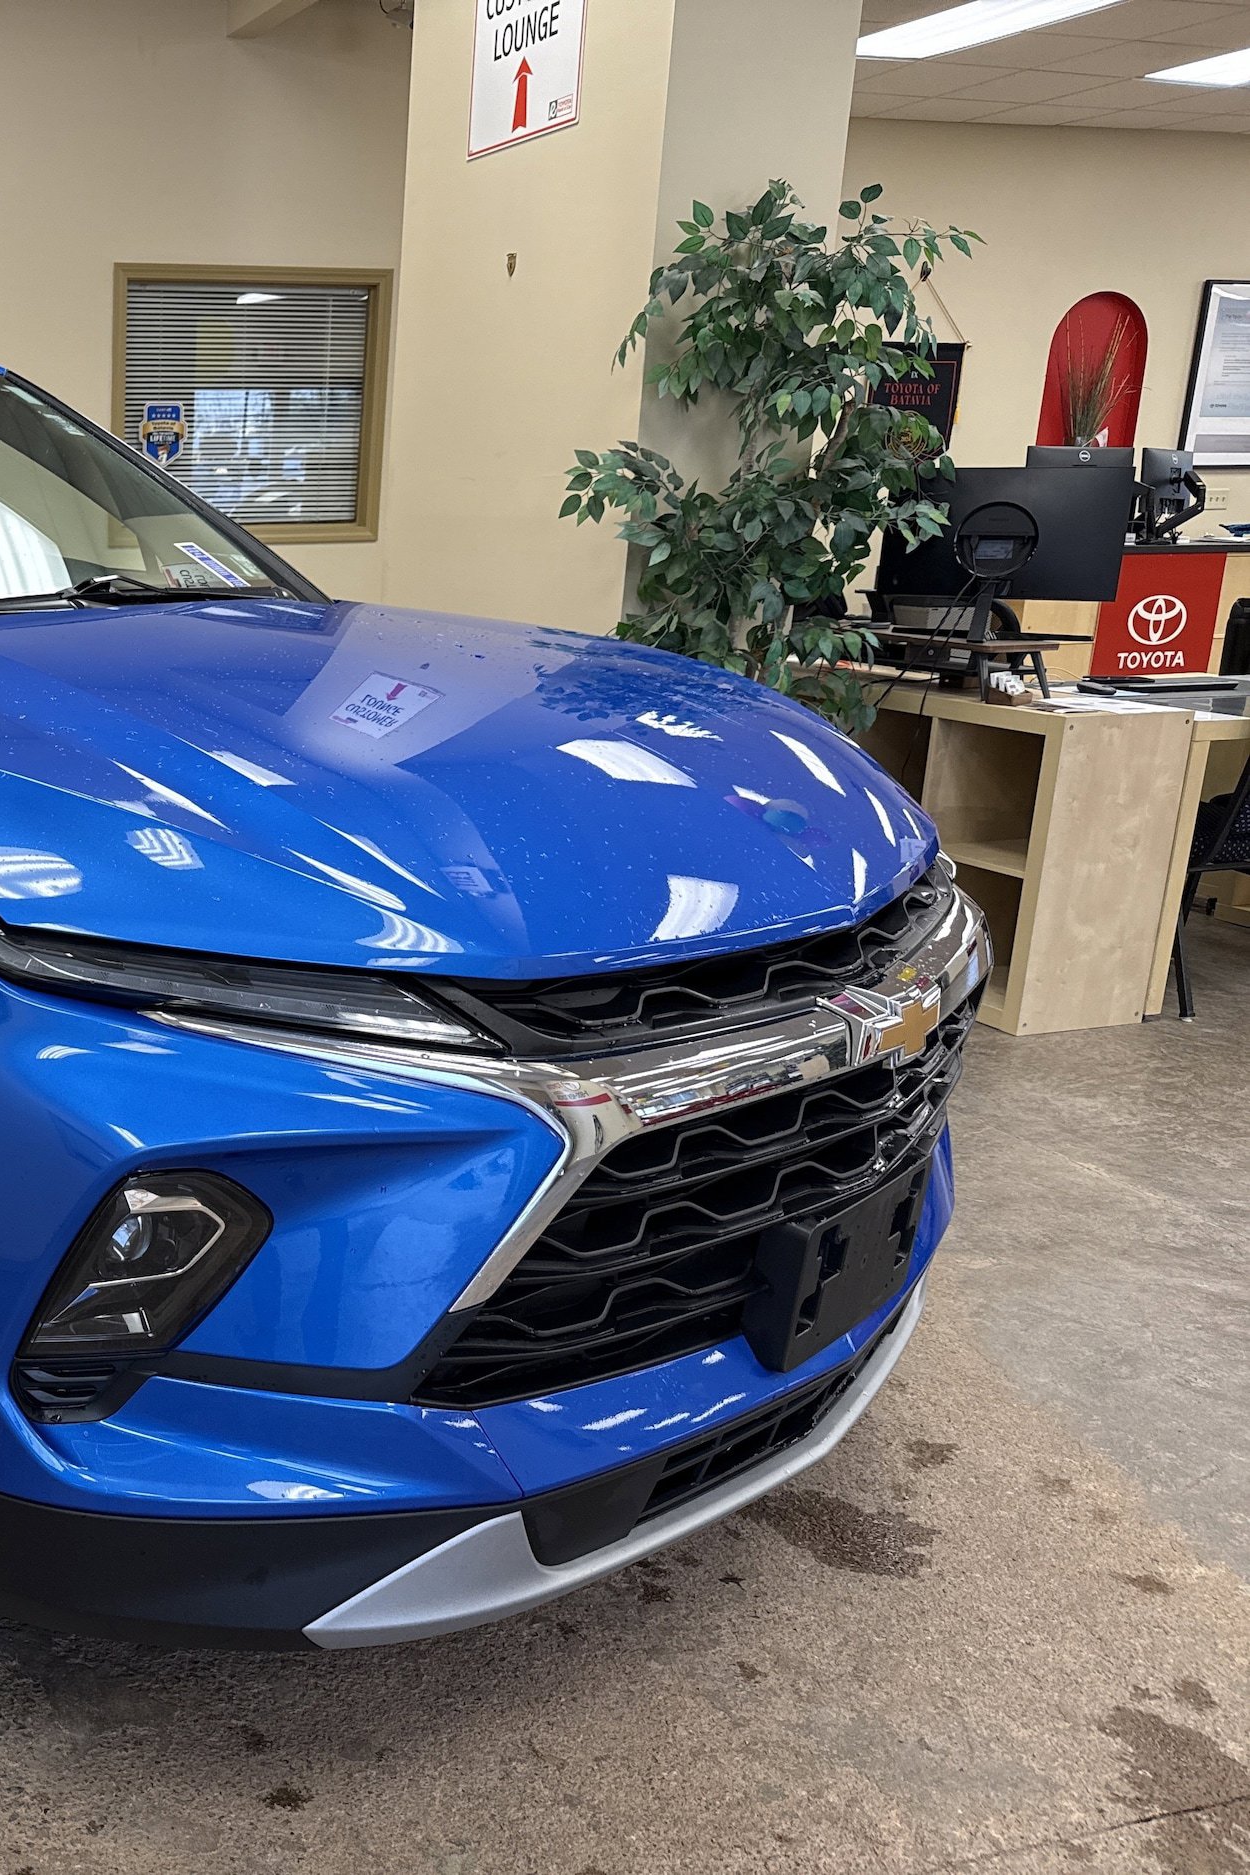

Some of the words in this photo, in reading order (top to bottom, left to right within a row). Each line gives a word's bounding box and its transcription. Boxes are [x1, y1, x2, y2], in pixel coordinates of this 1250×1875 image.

[494, 1, 561, 62] LOUNGE
[884, 383, 924, 395] TOYOTA
[927, 383, 942, 394] OF
[890, 394, 932, 406] BATAVIA
[1117, 650, 1185, 669] TOYOTA
